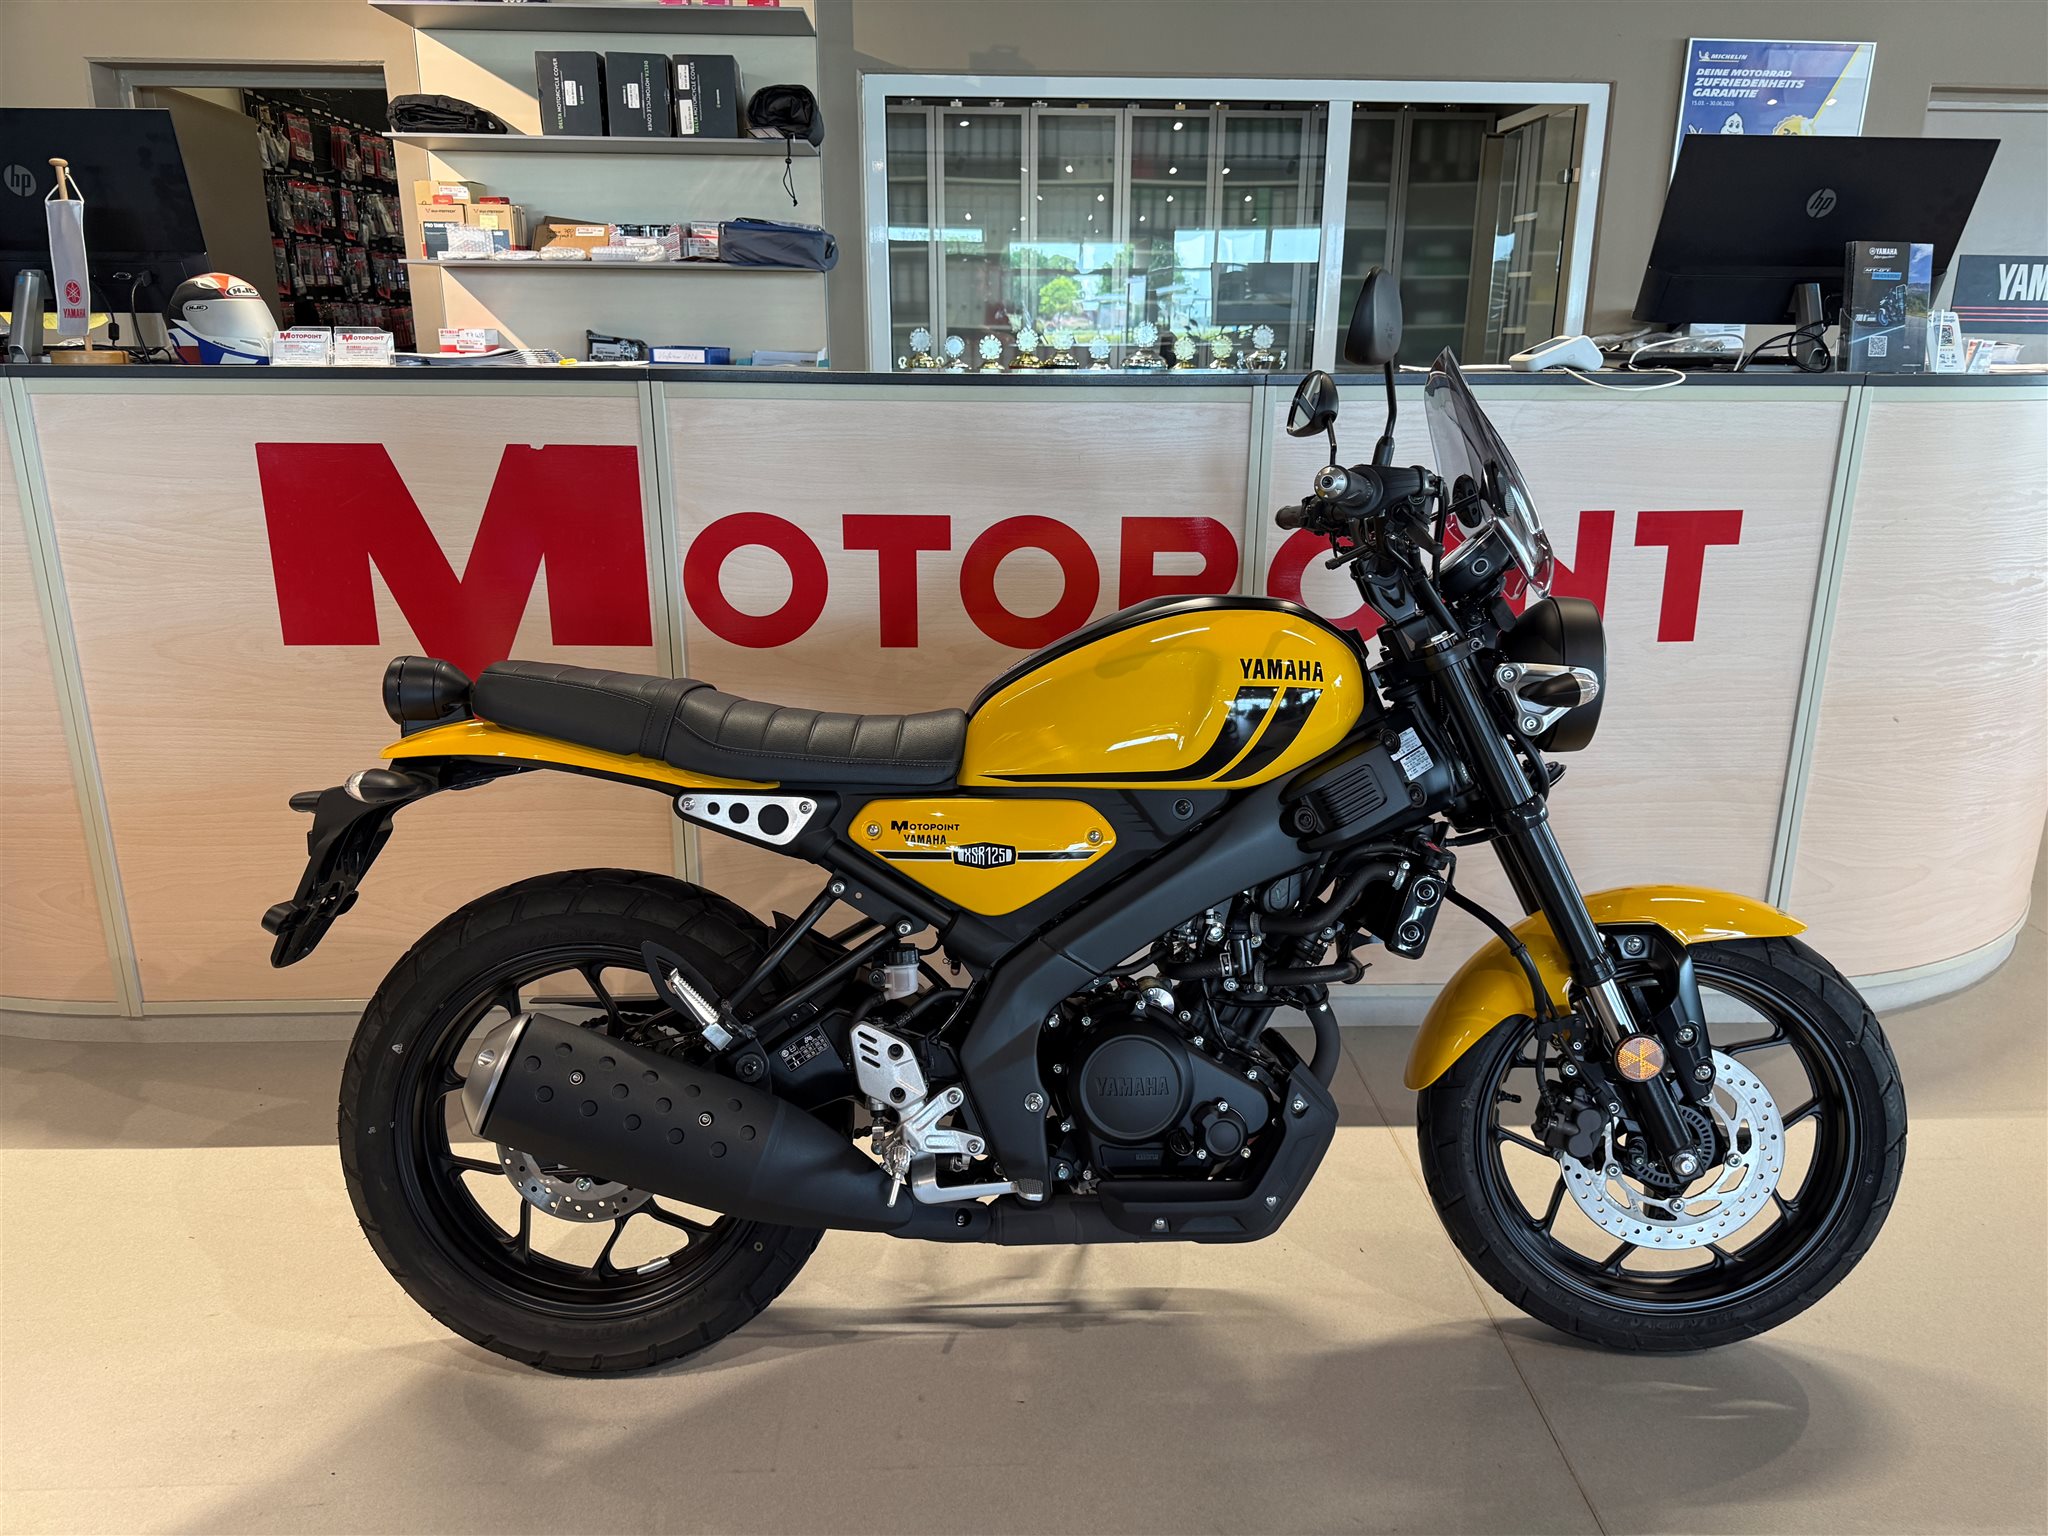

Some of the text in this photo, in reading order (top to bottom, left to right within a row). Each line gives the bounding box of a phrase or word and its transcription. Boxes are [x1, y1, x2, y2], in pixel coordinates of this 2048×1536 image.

[1696, 68, 1792, 78] DEINE MOTORRAD
[1694, 77, 1806, 89] ZUFRIEDENHEITS
[554, 77, 562, 113] MOTORCYCLE
[1692, 88, 1759, 98] GARANTIE
[9, 164, 32, 197] hp
[1808, 189, 1835, 218] hp
[1876, 247, 1898, 255] YAMAHA
[63, 307, 87, 319] YAMAHA
[280, 332, 322, 340] MOTOPOINT
[342, 334, 384, 342] MOTOPOINT
[1240, 658, 1324, 682] YAMAHA
[891, 820, 960, 834] MOTOPOINT
[903, 834, 947, 845] YAMAHA
[963, 847, 1006, 866] XSR125
[1095, 1076, 1170, 1097] YAMAHA
